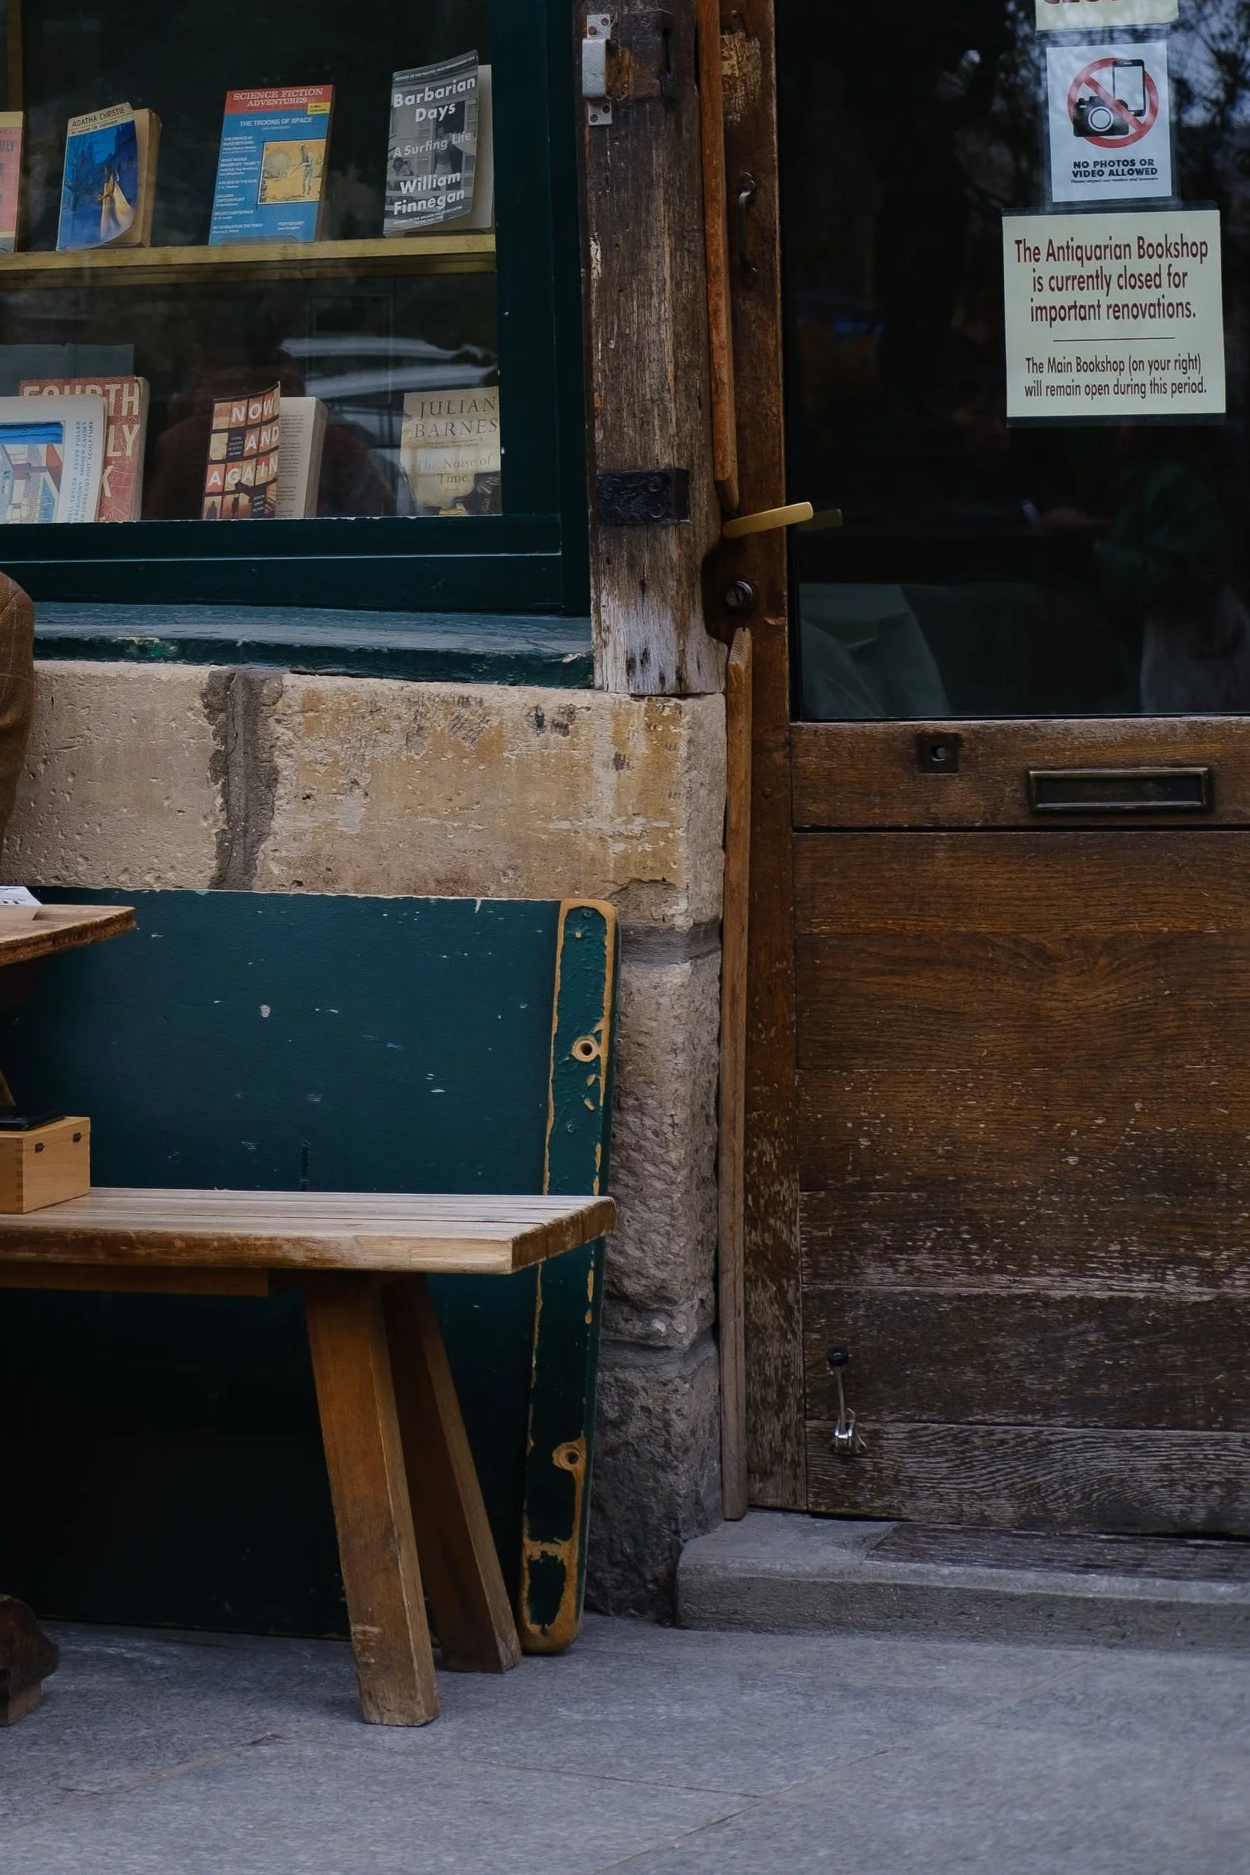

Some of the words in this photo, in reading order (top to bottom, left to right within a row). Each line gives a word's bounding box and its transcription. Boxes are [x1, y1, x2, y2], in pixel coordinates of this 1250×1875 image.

[233, 90, 279, 101] SCIENCE
[281, 88, 324, 98] FICTION
[247, 96, 308, 107] ADVENTURES
[393, 77, 476, 108] Barbarian
[71, 114, 98, 127] AGATHA
[99, 106, 126, 121] CHRISTIE
[415, 103, 456, 122] Days
[392, 146, 403, 158] A
[404, 139, 448, 157] Surfing
[451, 131, 472, 145] Life
[1072, 169, 1105, 178] VIDEO
[1108, 167, 1158, 176] ALLOWED
[1073, 161, 1089, 169] NO
[1093, 159, 1136, 168] PHOTOS
[1139, 158, 1154, 166] OR
[400, 171, 462, 195] William
[393, 189, 465, 216] Finnegan
[1015, 238, 1041, 263] The
[1046, 235, 1131, 267] Antiquarian
[1137, 233, 1208, 264] Bookshop
[1032, 268, 1043, 292] is
[1048, 265, 1112, 297] currently
[1117, 264, 1162, 290] closed
[1167, 263, 1188, 288] for
[1030, 298, 1101, 328] important
[1106, 294, 1196, 320] renovations.
[1025, 357, 1044, 373] The
[1047, 356, 1072, 373] Main
[1076, 354, 1125, 376] Bookshop
[1128, 355, 1145, 375] (on
[1147, 357, 1171, 375] your
[1174, 353, 1201, 374] right)
[1024, 380, 1042, 397] will
[1045, 379, 1081, 397] remain
[1084, 381, 1110, 400] open
[1113, 378, 1146, 399] during
[1150, 376, 1168, 395] this
[1171, 376, 1207, 398] period.
[231, 397, 275, 424] NOW
[418, 396, 498, 421] JULIAN
[245, 426, 279, 450] AND
[414, 416, 499, 439] BARNES
[208, 457, 278, 487] AGAIN
